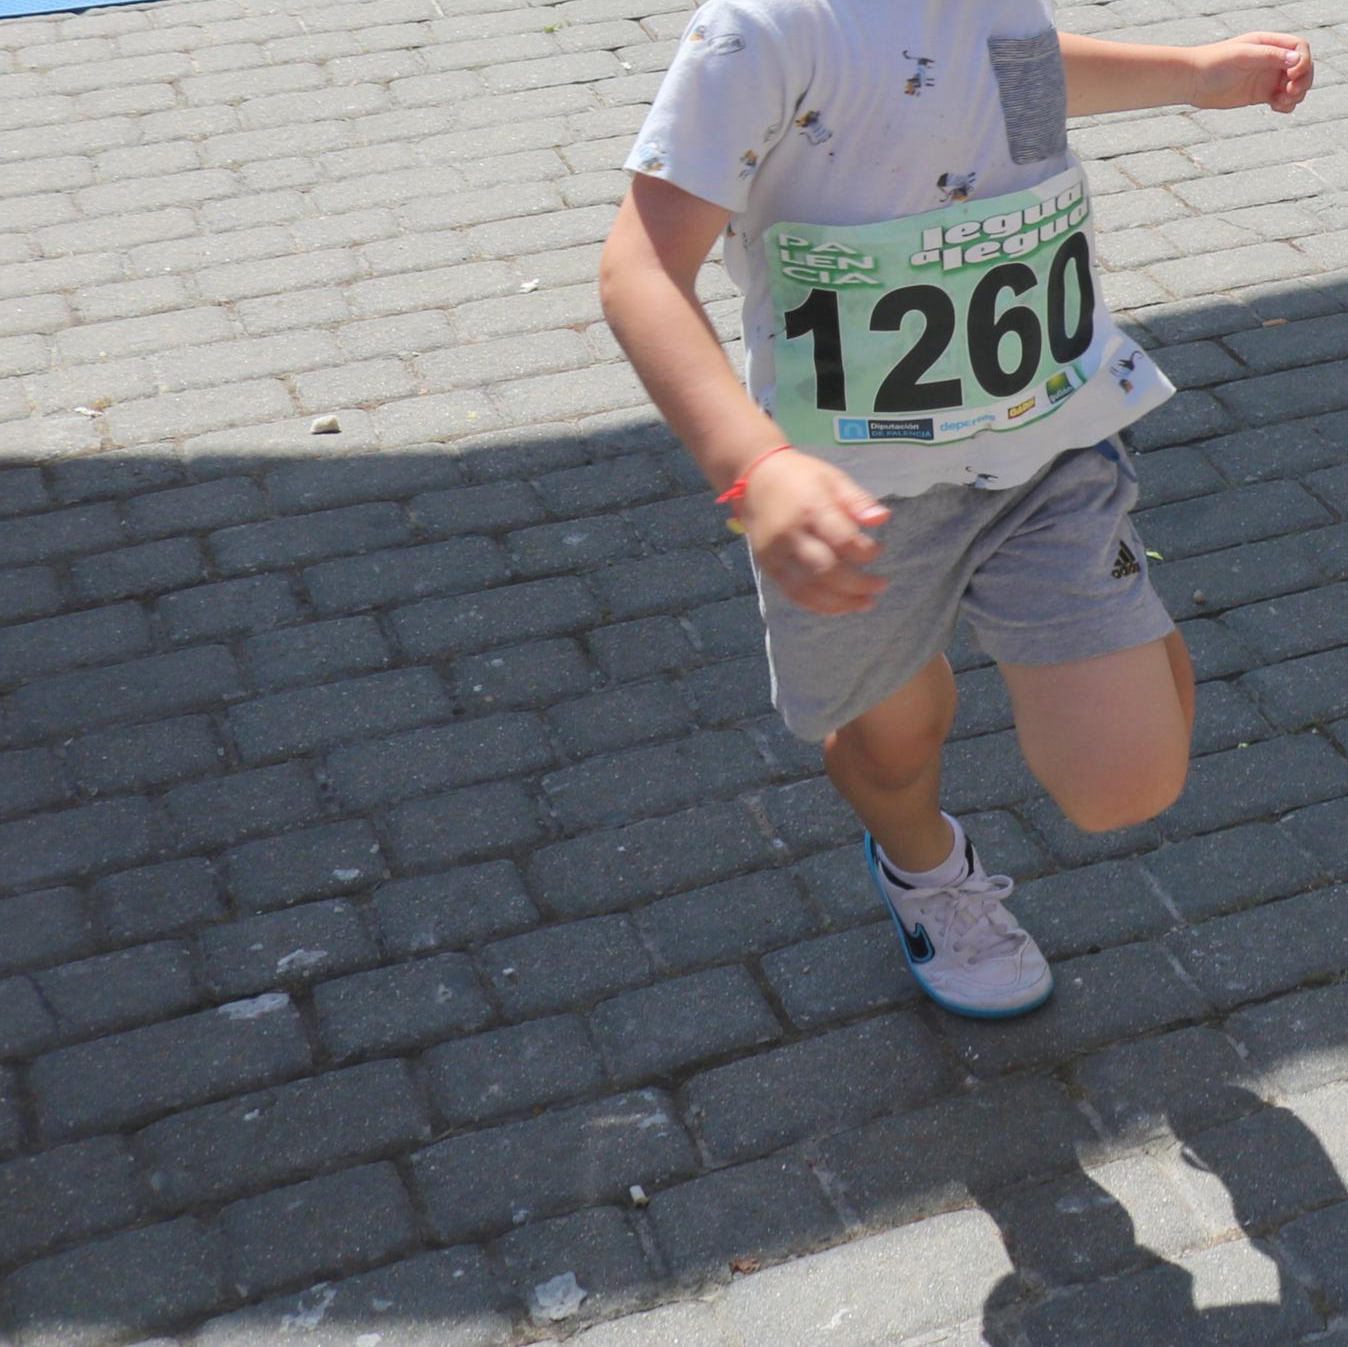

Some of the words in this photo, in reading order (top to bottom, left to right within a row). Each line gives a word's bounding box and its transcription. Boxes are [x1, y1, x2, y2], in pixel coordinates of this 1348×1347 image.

[922, 181, 1085, 251] legua
[942, 200, 1090, 273] legua
[784, 231, 1096, 413] 1260
[870, 421, 919, 431] Diputación
